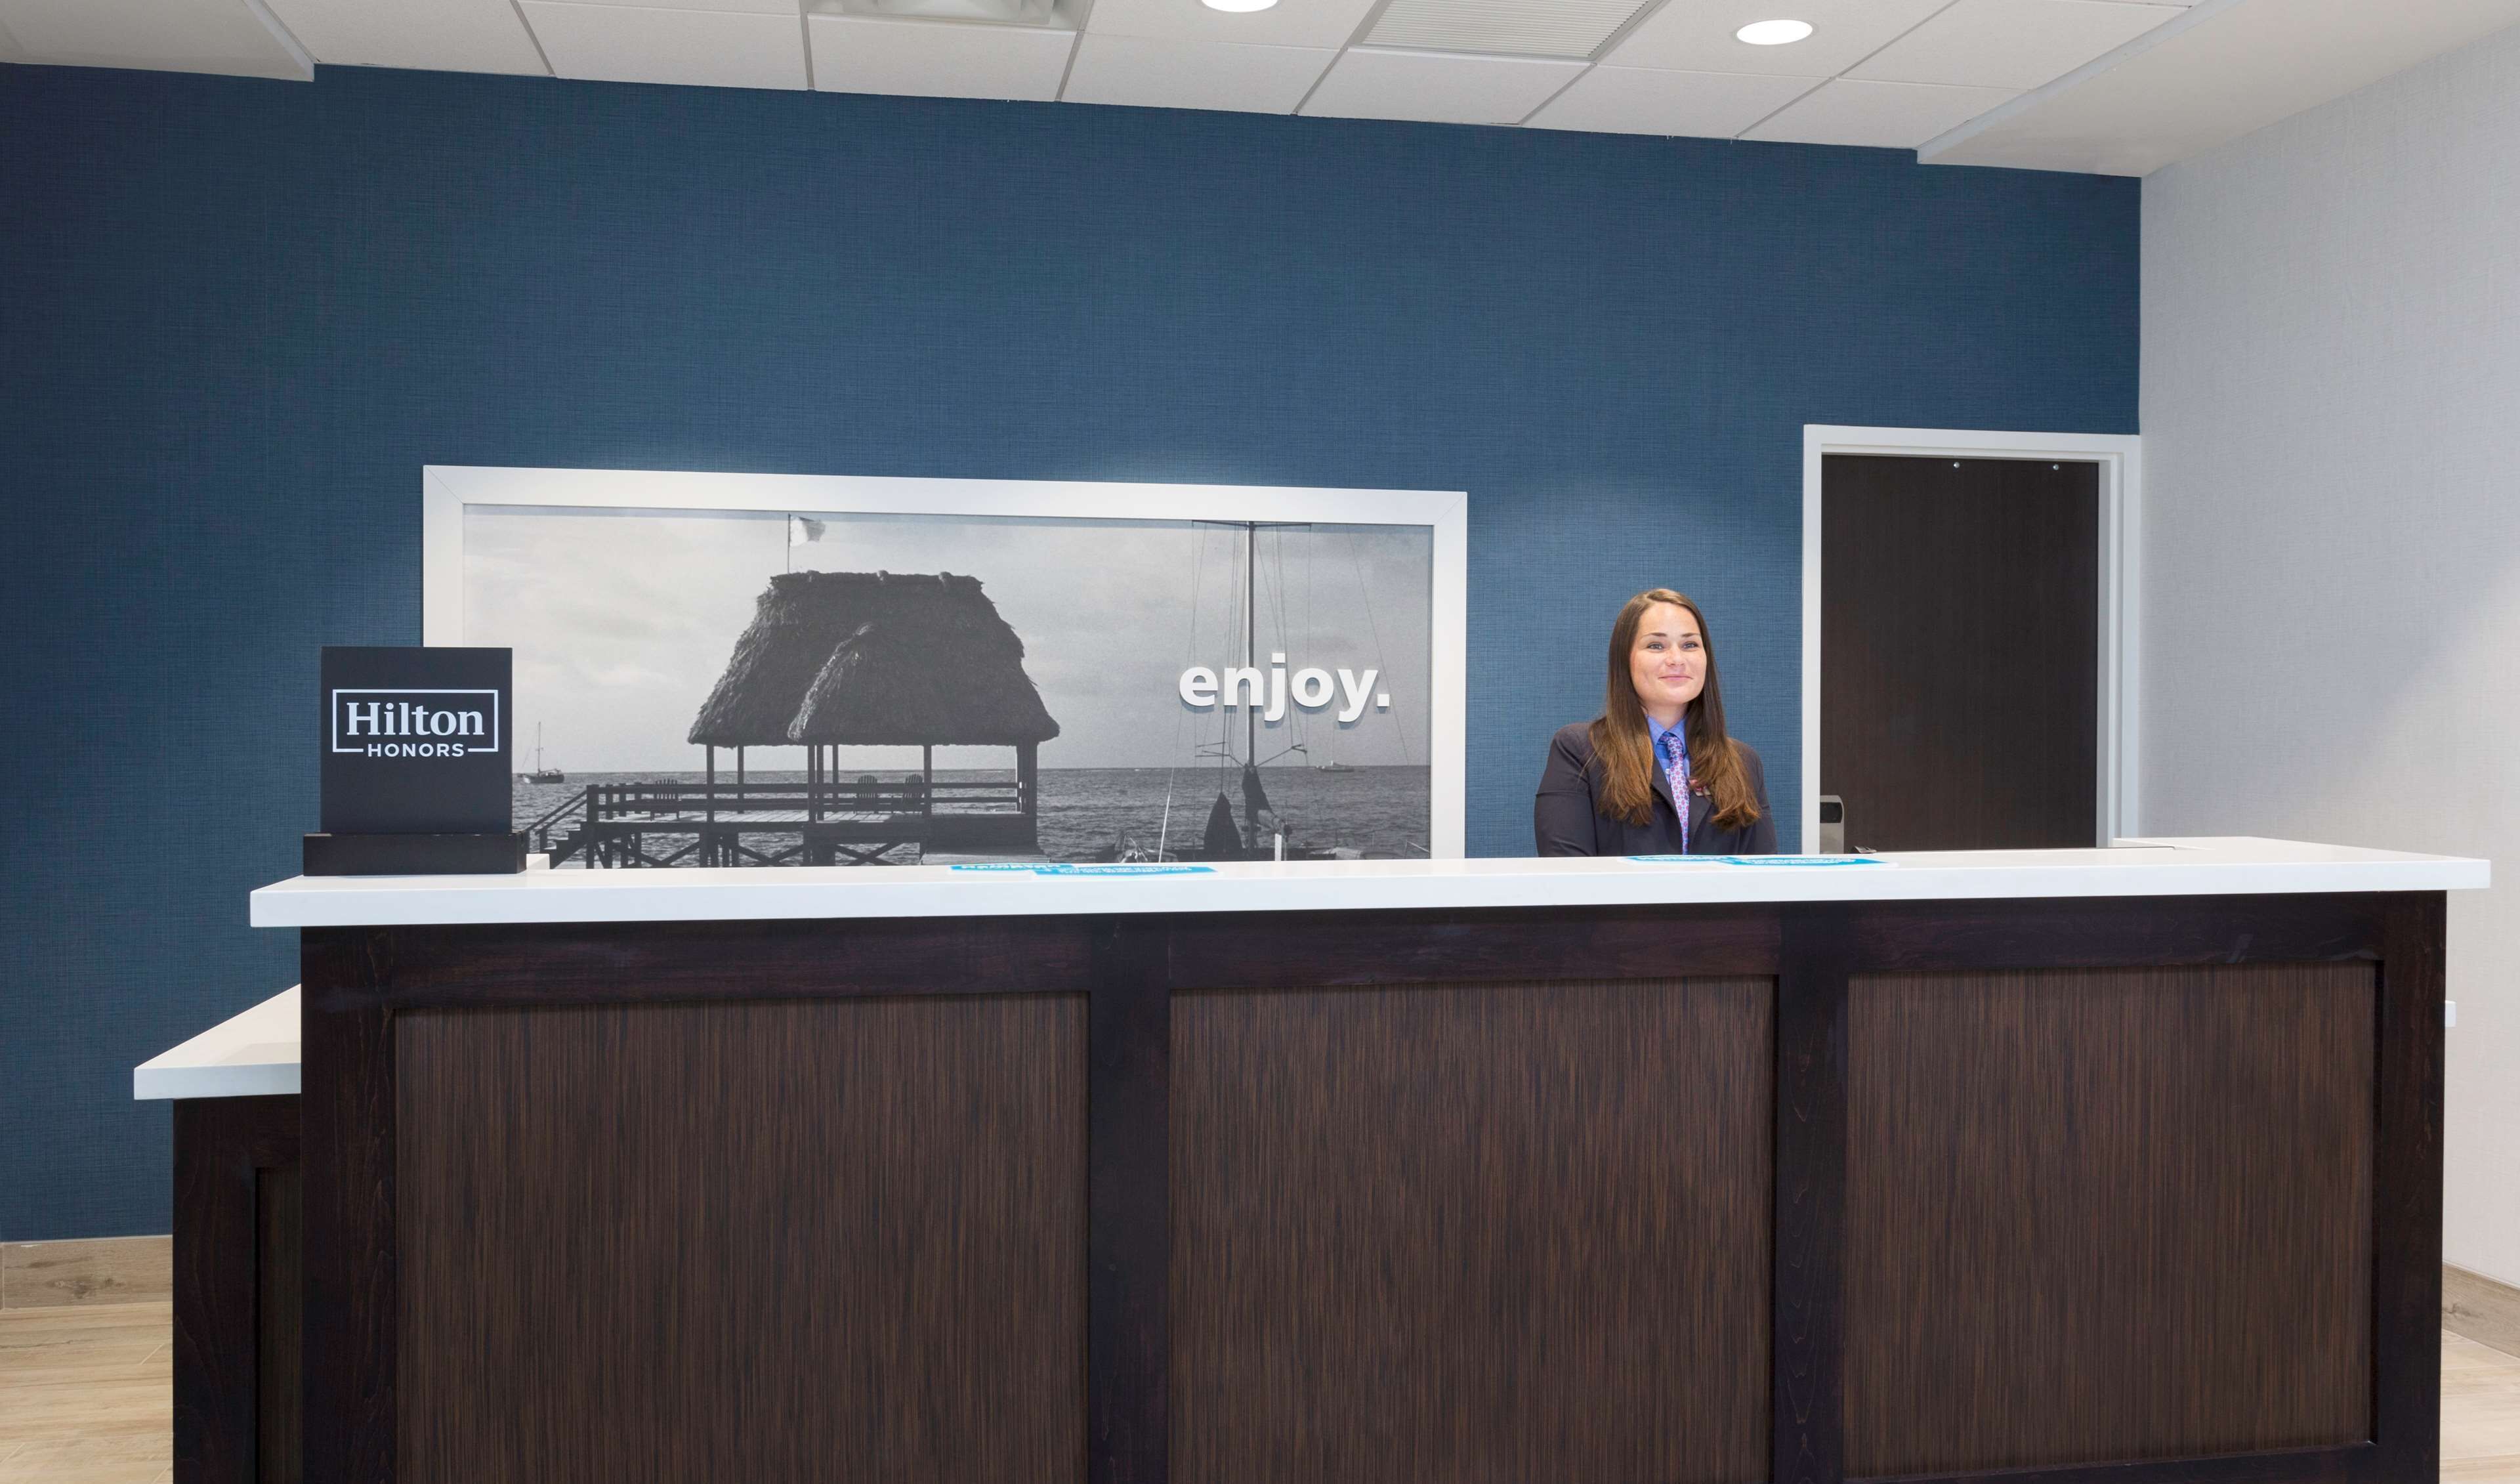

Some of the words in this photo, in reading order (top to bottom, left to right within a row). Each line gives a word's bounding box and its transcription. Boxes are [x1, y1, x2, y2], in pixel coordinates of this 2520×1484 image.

[1179, 652, 1391, 723] enjoy.
[346, 702, 485, 736] Hilton
[368, 743, 465, 757] HONORS
